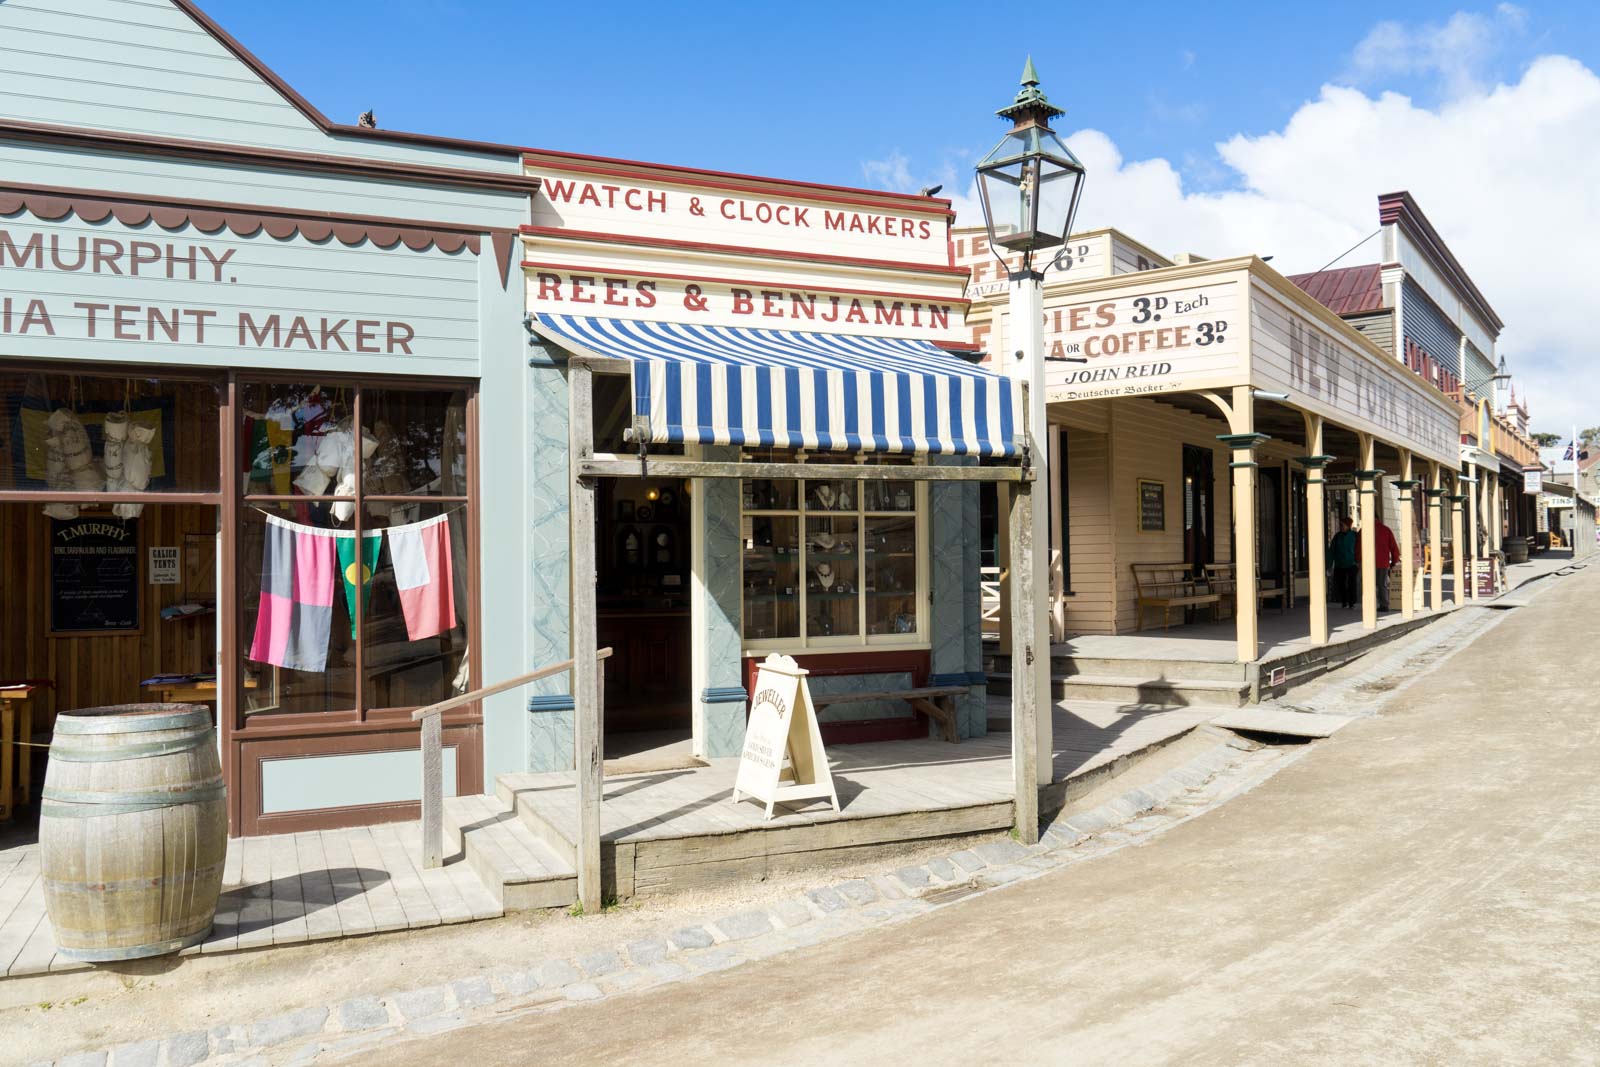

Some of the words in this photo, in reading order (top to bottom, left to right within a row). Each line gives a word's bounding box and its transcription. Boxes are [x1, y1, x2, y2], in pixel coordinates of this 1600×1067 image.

[543, 178, 666, 213] WATCH
[688, 196, 704, 218] &
[720, 198, 810, 228] CLOCK
[824, 210, 931, 240] MAKERS
[537, 272, 656, 308] REES
[683, 283, 709, 312] &
[730, 288, 950, 330] BENJAMIN
[1043, 302, 1117, 334] IES
[1175, 294, 1209, 314] Each
[74, 302, 217, 344] TENT
[238, 312, 415, 355] MAKER
[1066, 343, 1080, 354] OR
[1084, 325, 1191, 359] COFFEE
[1064, 366, 1120, 385] JOHN
[1125, 361, 1173, 379] REID
[1289, 316, 1340, 408] NEW
[152, 549, 177, 559] CALICO
[153, 559, 176, 569] TENTS
[754, 688, 786, 720] JEWELLER
